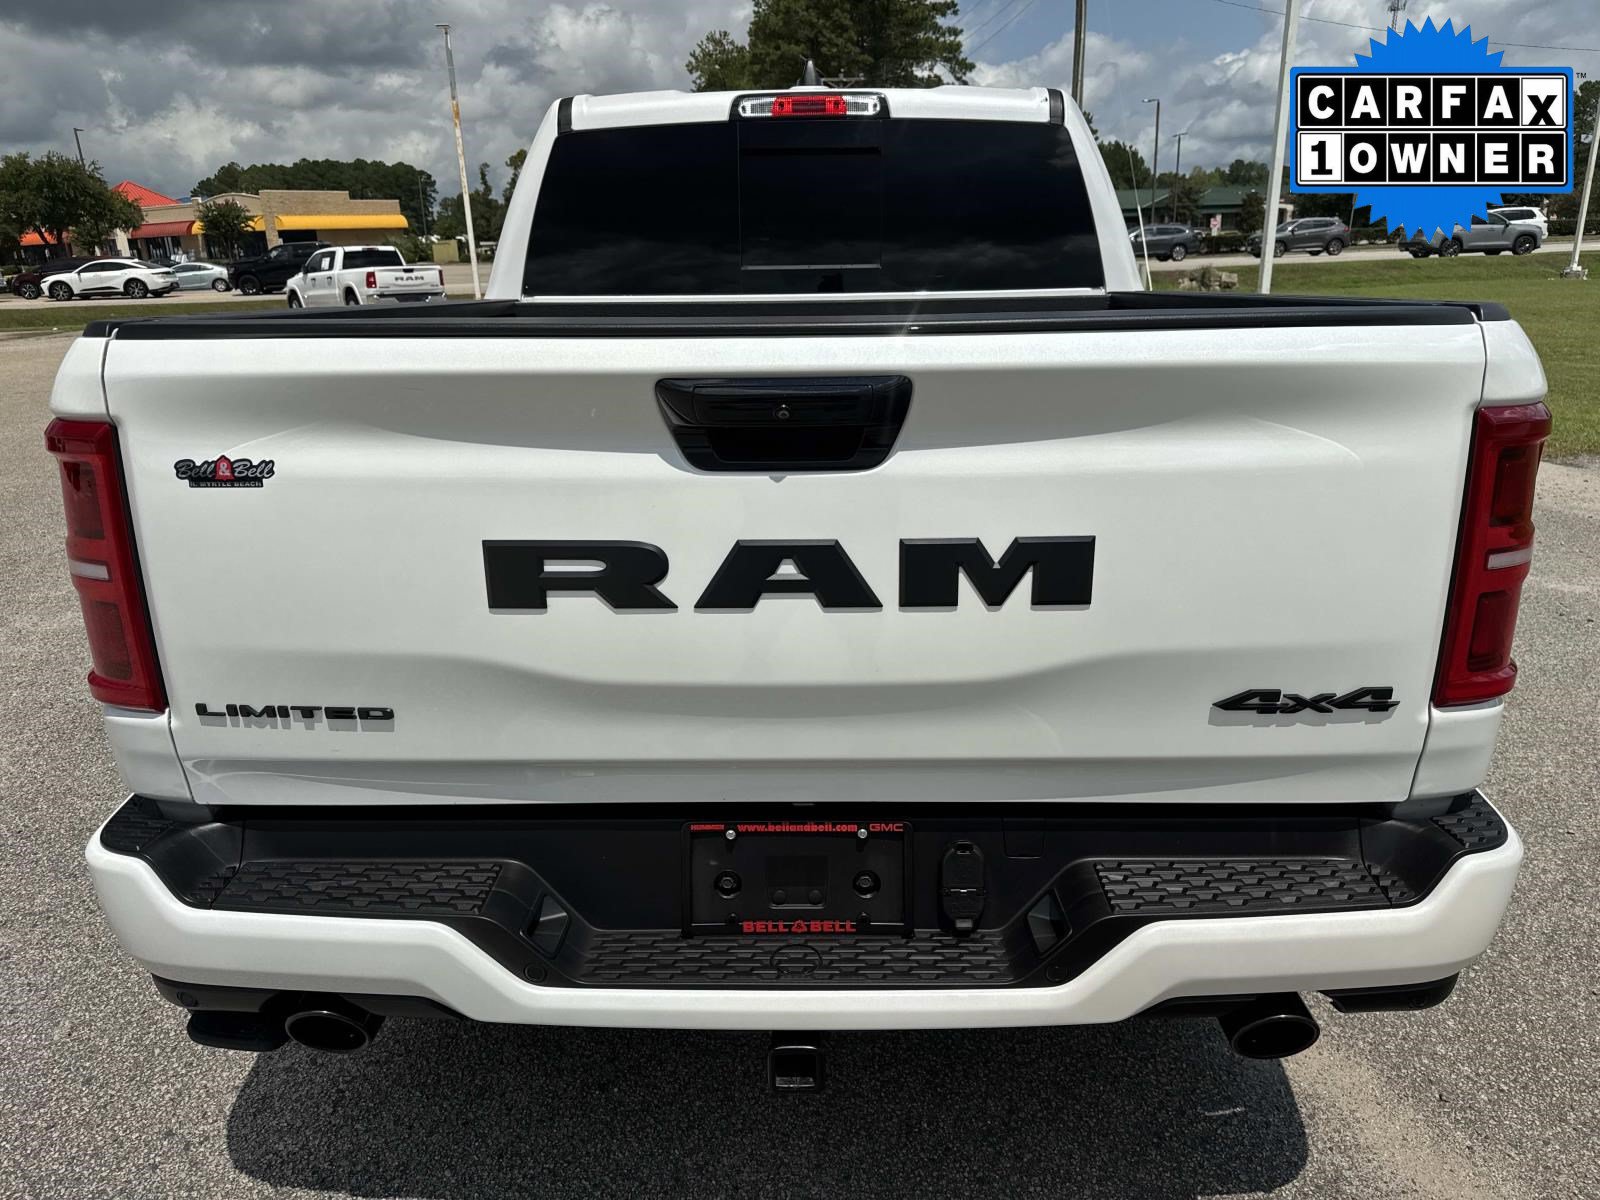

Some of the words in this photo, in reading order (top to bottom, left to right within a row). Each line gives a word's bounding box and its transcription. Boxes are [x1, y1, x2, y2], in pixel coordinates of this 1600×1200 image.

[175, 460, 215, 478] Bell
[233, 460, 274, 477] Bell
[482, 536, 1096, 609] RAM
[195, 703, 394, 720] LIMITED
[737, 822, 857, 832] www.bellandbell.com
[869, 823, 904, 831] GMC
[743, 921, 788, 932] BELL
[810, 921, 856, 932] BELL
